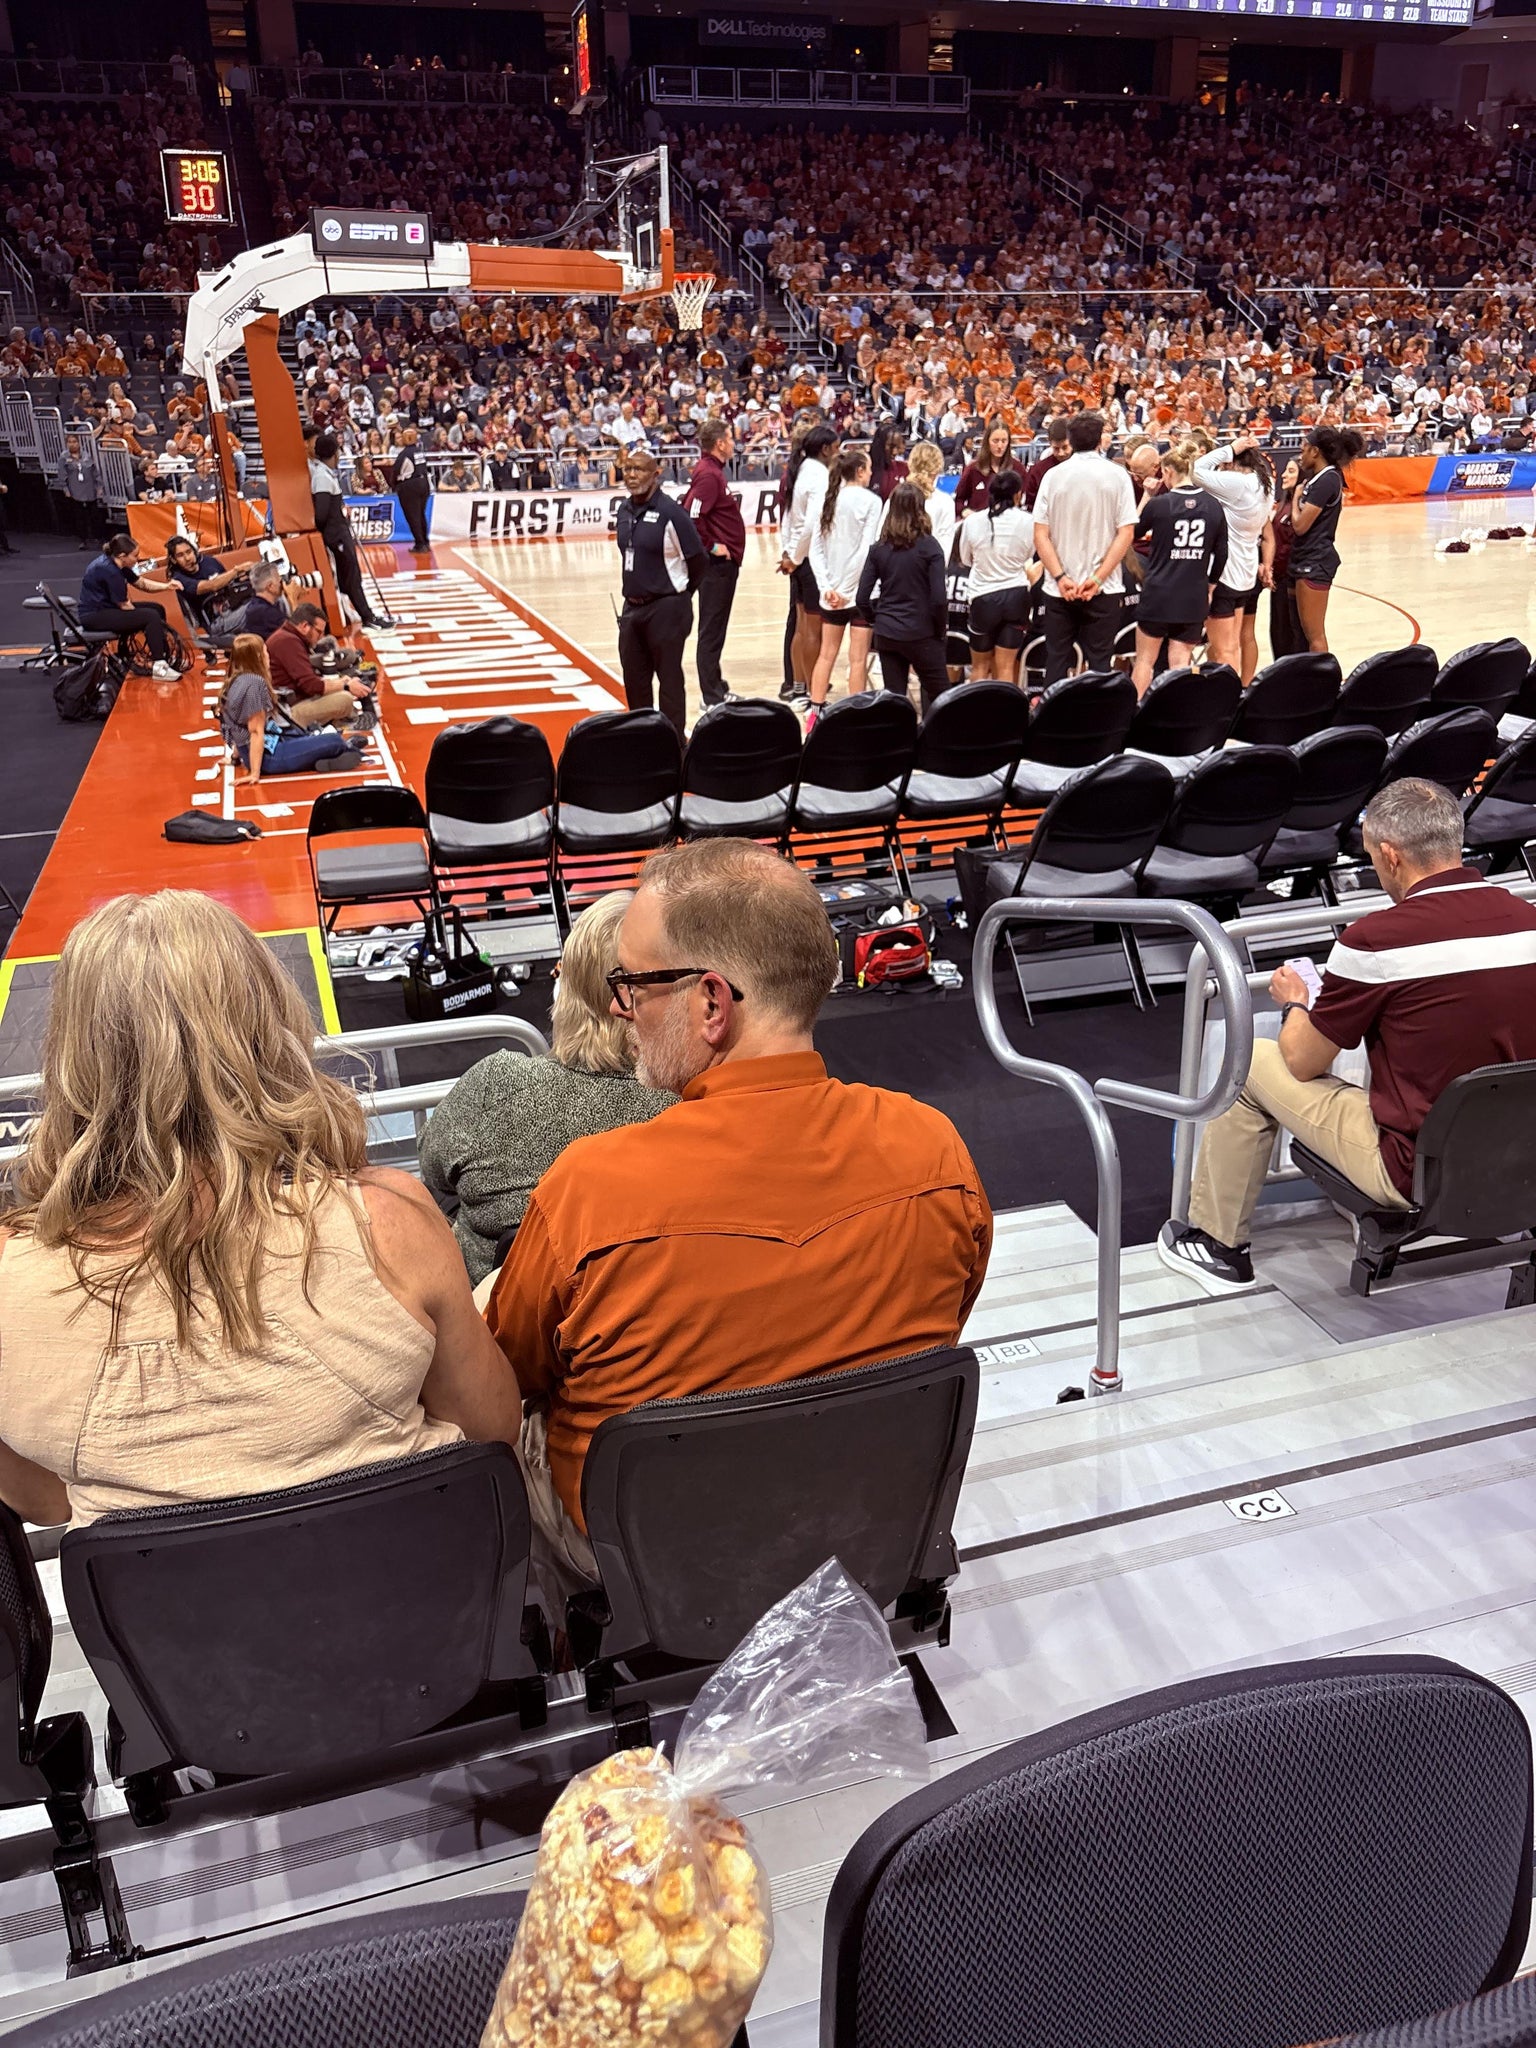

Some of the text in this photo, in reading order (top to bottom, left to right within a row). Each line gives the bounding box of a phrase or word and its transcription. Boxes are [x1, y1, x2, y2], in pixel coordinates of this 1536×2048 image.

[1286, 0, 1295, 15] 3
[1430, 8, 1448, 22] TEAM
[1448, 9, 1469, 23] STATS
[707, 19, 826, 41] DELL Technologies
[180, 159, 220, 183] 3:06
[182, 184, 216, 211] 30
[177, 212, 222, 220] DAKTRONICS
[349, 222, 398, 241] ESPN
[1464, 462, 1500, 476] MARCH
[1465, 472, 1512, 486] MADNESS
[469, 497, 572, 538] FIRST
[572, 506, 602, 524] AND
[1173, 518, 1206, 548] 32
[442, 983, 493, 1009] BODYARMOR
[999, 1343, 1031, 1358] BB
[1239, 1497, 1282, 1517] CC
